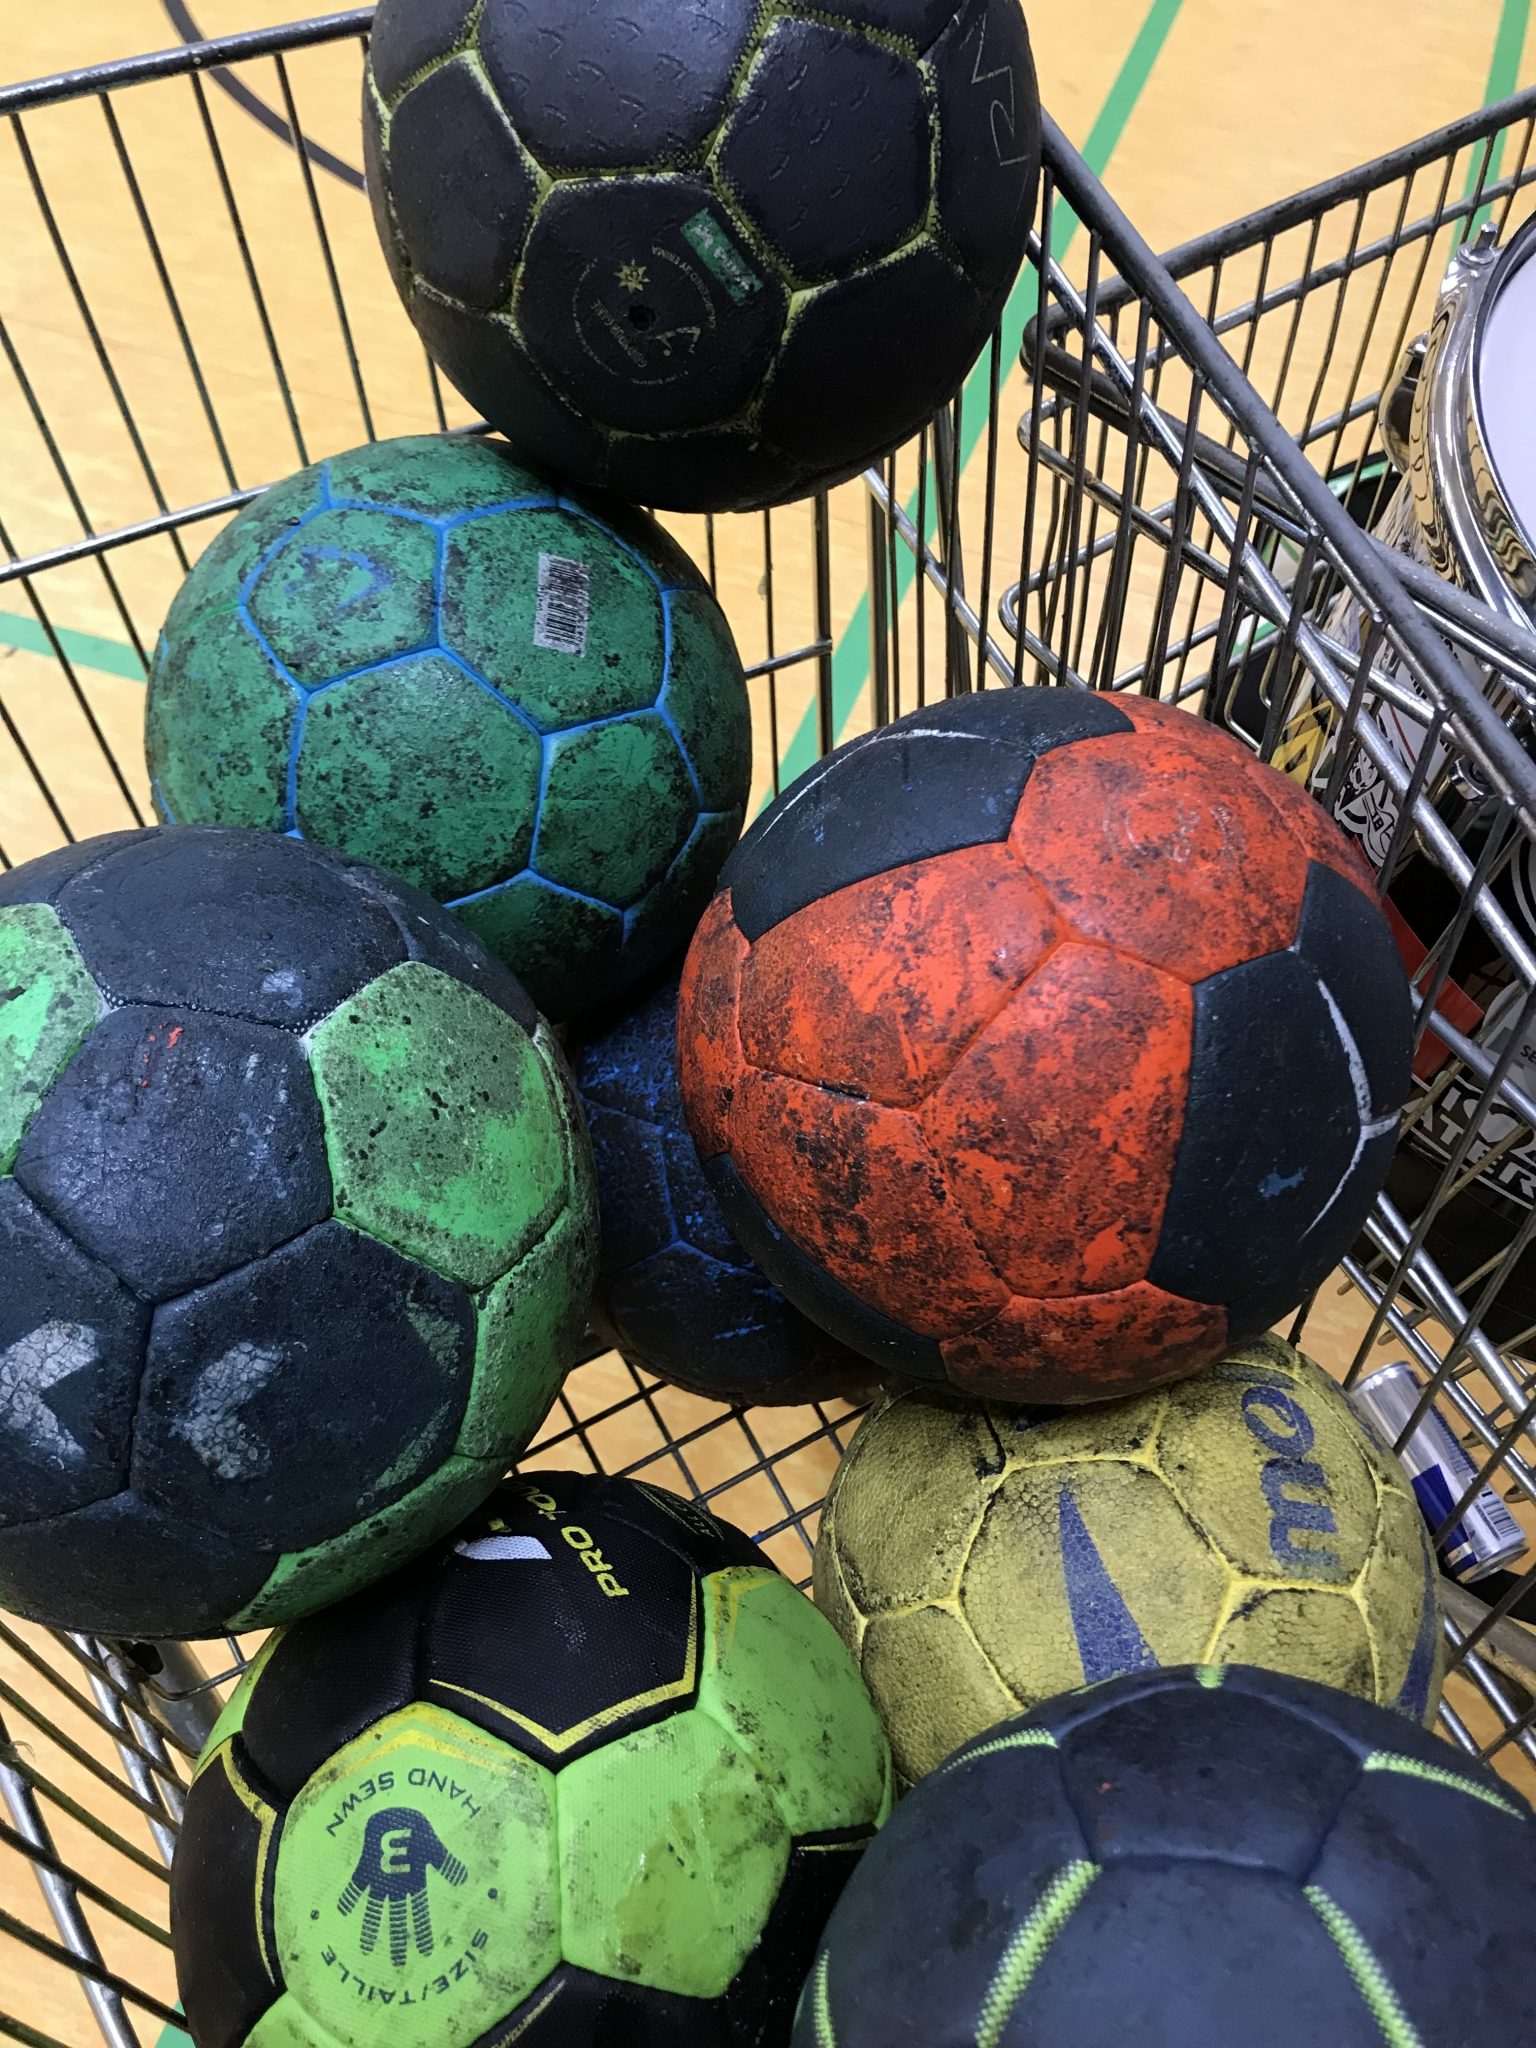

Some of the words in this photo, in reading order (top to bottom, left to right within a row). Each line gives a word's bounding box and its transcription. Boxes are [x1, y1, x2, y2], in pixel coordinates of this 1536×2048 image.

[561, 1526, 629, 1597] PRO
[326, 1771, 394, 1837] SEWN
[408, 1768, 481, 1818] HAND
[380, 1829, 412, 1874] 3
